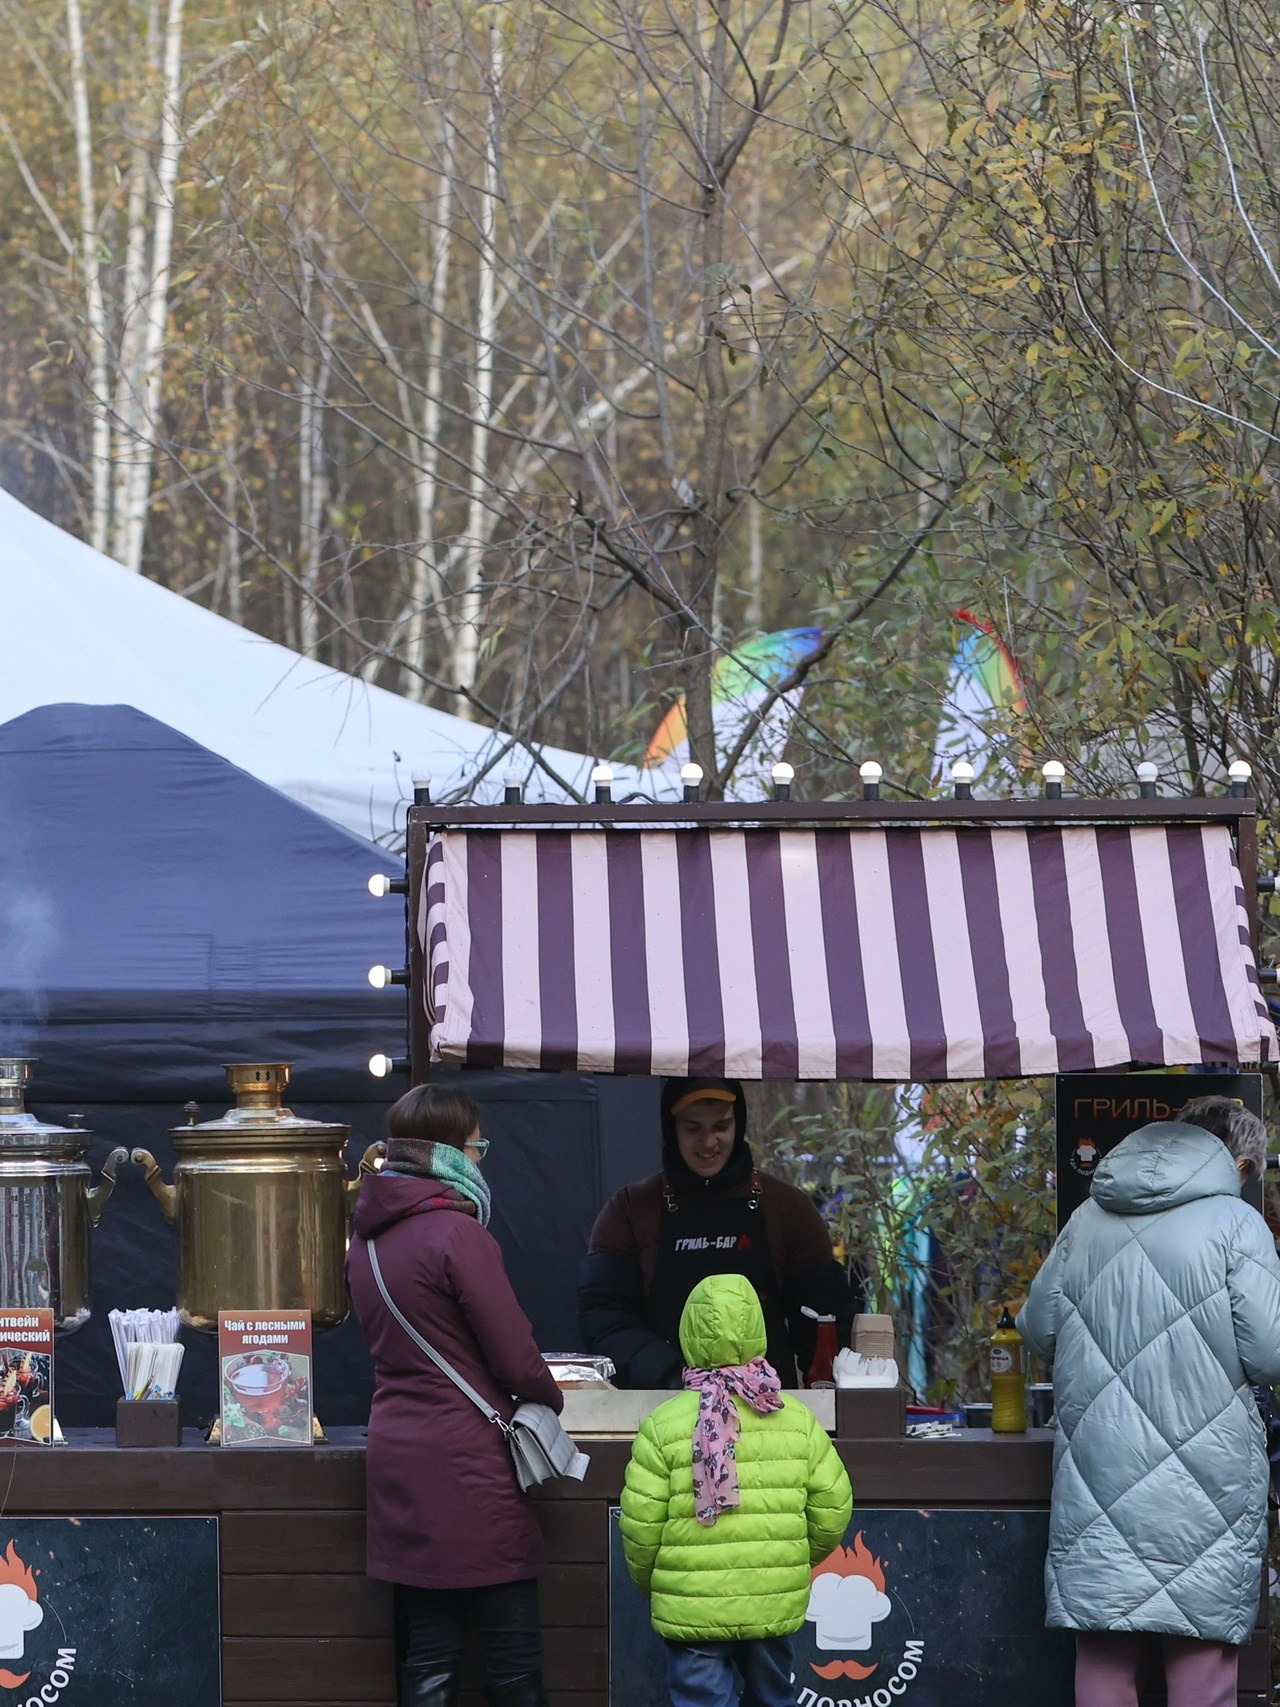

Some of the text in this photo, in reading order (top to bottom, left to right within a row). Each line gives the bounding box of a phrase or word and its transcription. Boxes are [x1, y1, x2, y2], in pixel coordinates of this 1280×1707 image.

[1074, 1098, 1243, 1119] ГРИЛЬ-
[674, 1236, 737, 1251] ГРИЛЬ-БАР
[224, 1320, 306, 1331] Чай с лесными
[242, 1334, 289, 1346] ягодами
